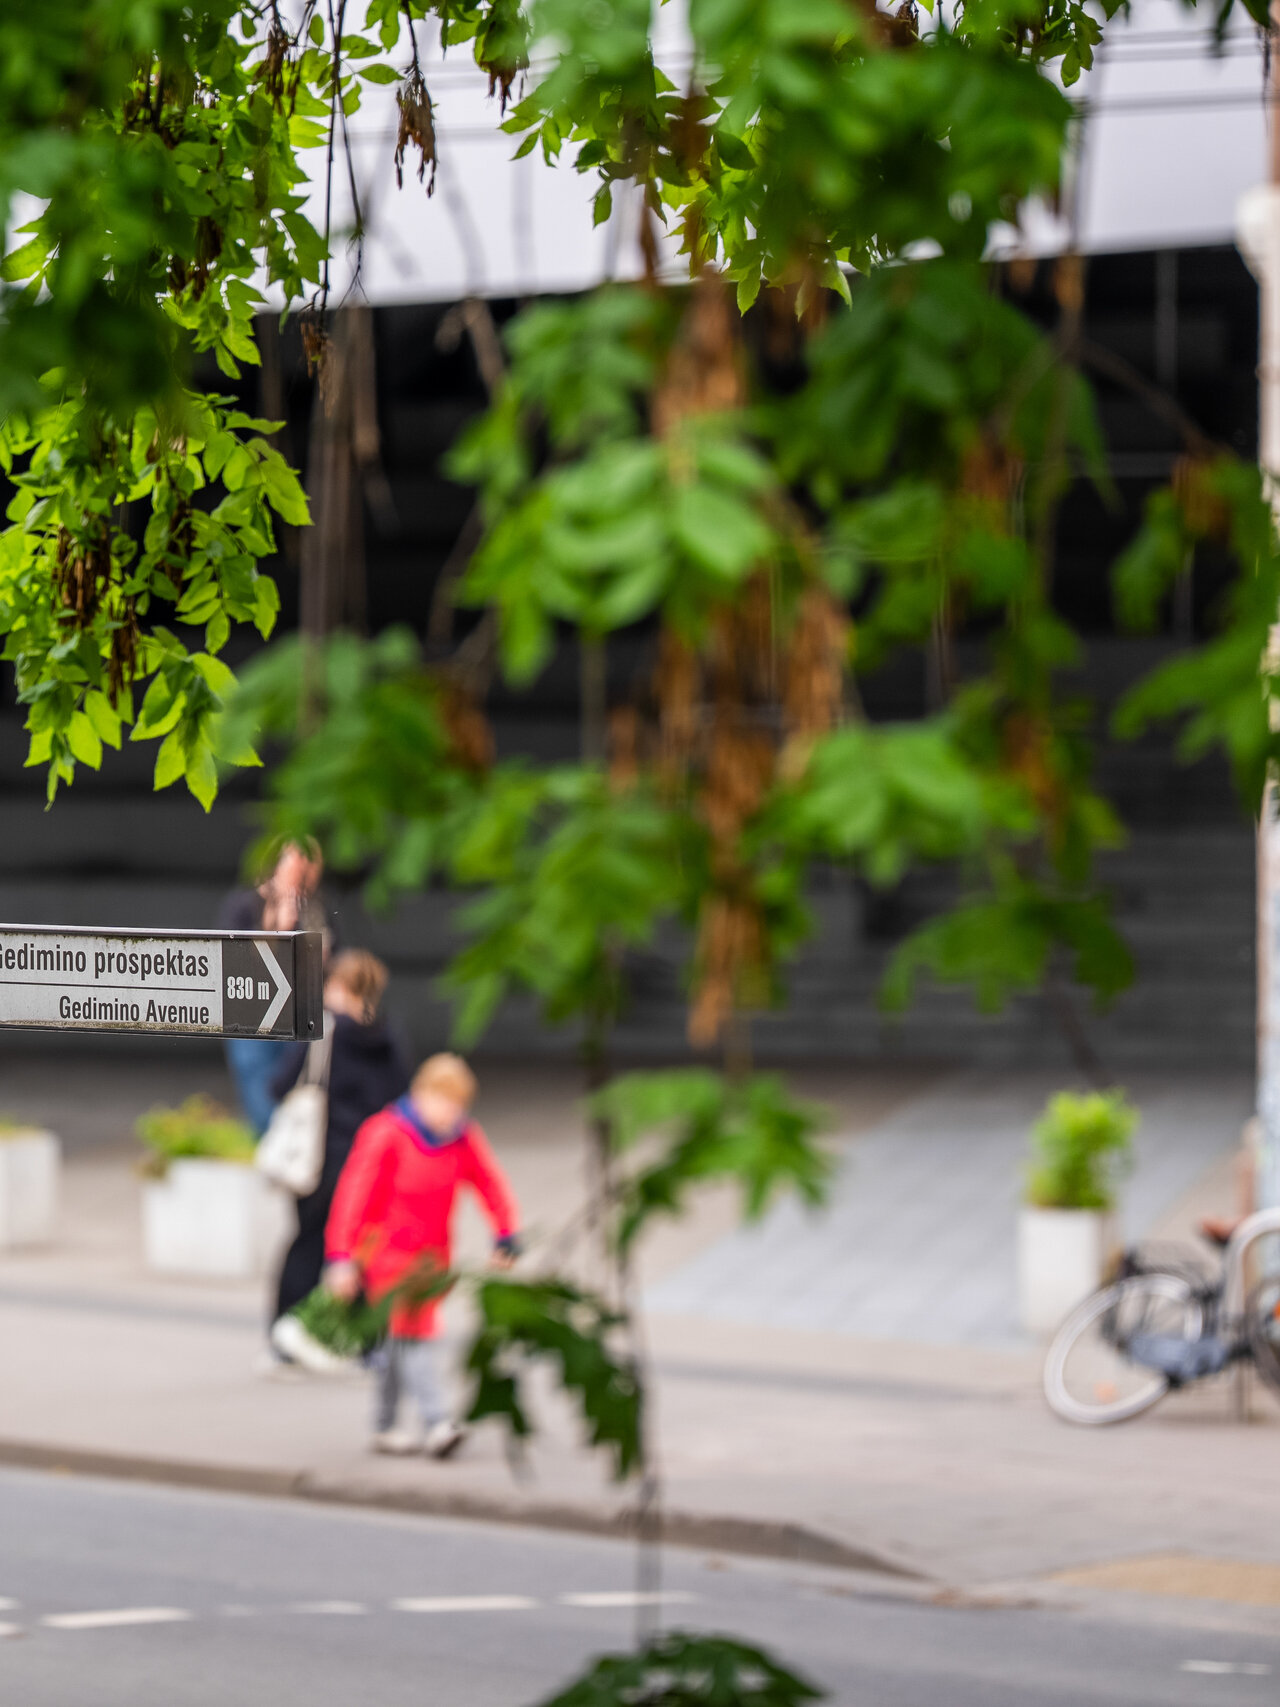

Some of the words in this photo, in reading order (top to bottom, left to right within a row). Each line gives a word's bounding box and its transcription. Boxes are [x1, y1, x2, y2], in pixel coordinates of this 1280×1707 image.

[94, 946, 209, 979] prospektas
[227, 976, 254, 1000] 830
[257, 981, 270, 1001] m
[59, 996, 140, 1023] Gedimino
[145, 999, 210, 1025] Avenue
